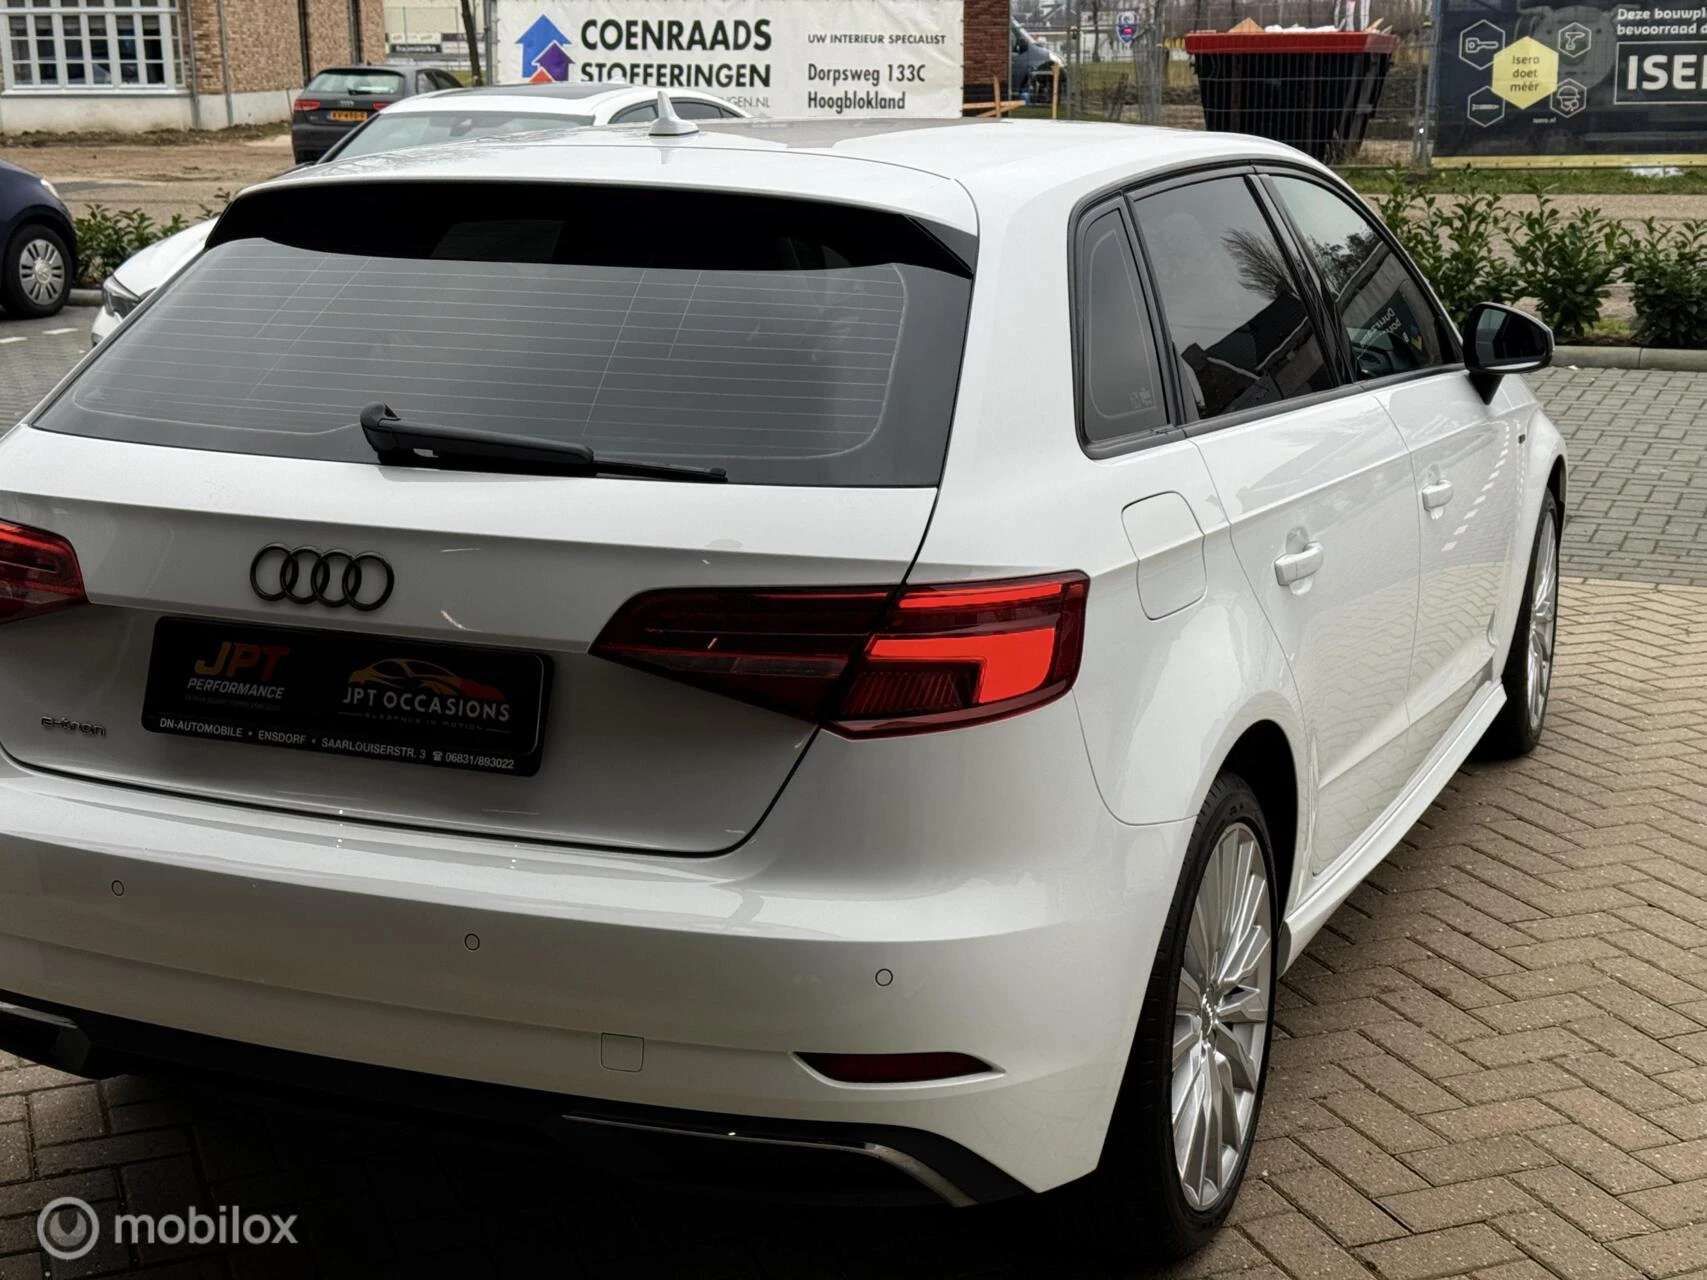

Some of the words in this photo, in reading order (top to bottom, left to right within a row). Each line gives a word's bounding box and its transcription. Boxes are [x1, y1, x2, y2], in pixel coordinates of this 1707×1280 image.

[1617, 8, 1651, 20] Deze
[1654, 7, 1707, 21] bouwpl
[580, 18, 772, 52] COENRAADS
[808, 34, 827, 43] UW
[830, 34, 885, 44] INTERIEUR
[888, 34, 947, 45] SPECIALIST
[1617, 22, 1697, 35] bevoorraad
[1512, 55, 1540, 65] Isero
[580, 62, 771, 88] STOFFERINGEN
[808, 63, 880, 87] Dorpsweg
[887, 64, 926, 82] 133C
[1512, 68, 1538, 78] doet
[808, 90, 906, 114] Hoogblokland
[194, 641, 290, 681] JPT
[187, 677, 285, 700] PERFORMANCE
[342, 686, 377, 707] JPT
[383, 691, 510, 722] OCCASIONS
[160, 718, 243, 738] DN-AUTOMOBILE
[258, 730, 307, 744] ENSDORF
[321, 737, 417, 759] SAARLOUISERSTR.
[419, 750, 426, 759] 3
[445, 752, 515, 769] 06831/893022
